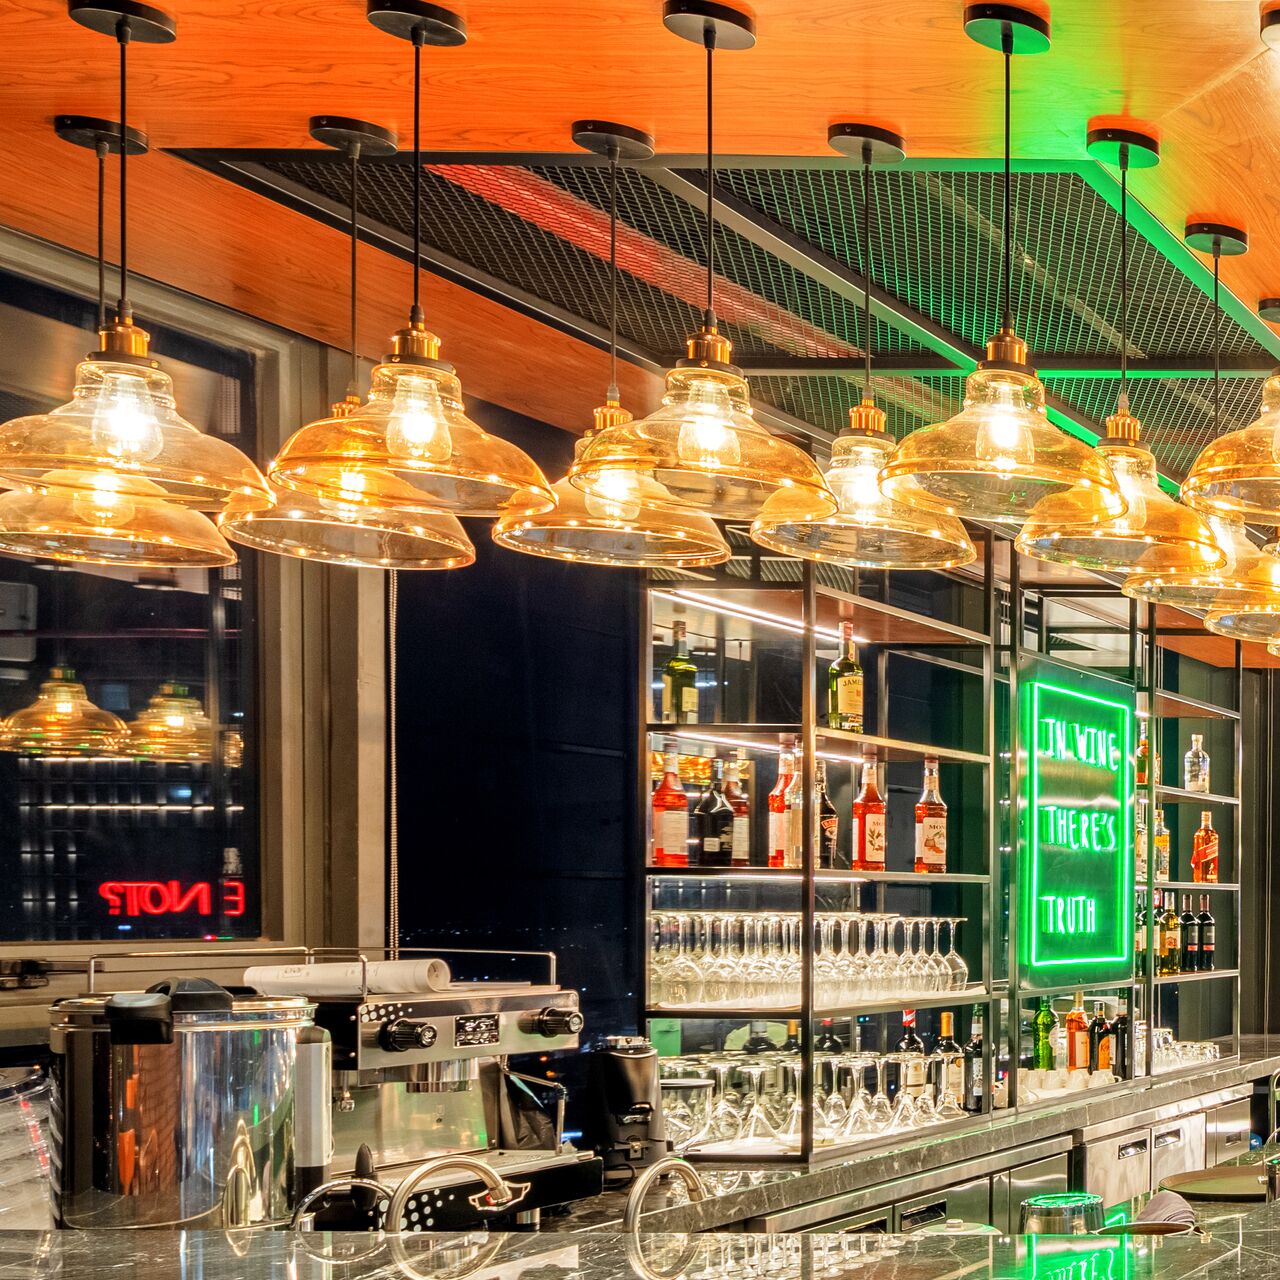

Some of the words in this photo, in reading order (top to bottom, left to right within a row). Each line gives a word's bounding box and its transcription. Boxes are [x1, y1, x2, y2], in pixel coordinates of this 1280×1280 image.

[1040, 718, 1067, 761] IN
[1069, 723, 1119, 771] WINE
[1040, 806, 1116, 851] THERE'S
[1039, 895, 1097, 935] TRUTH
